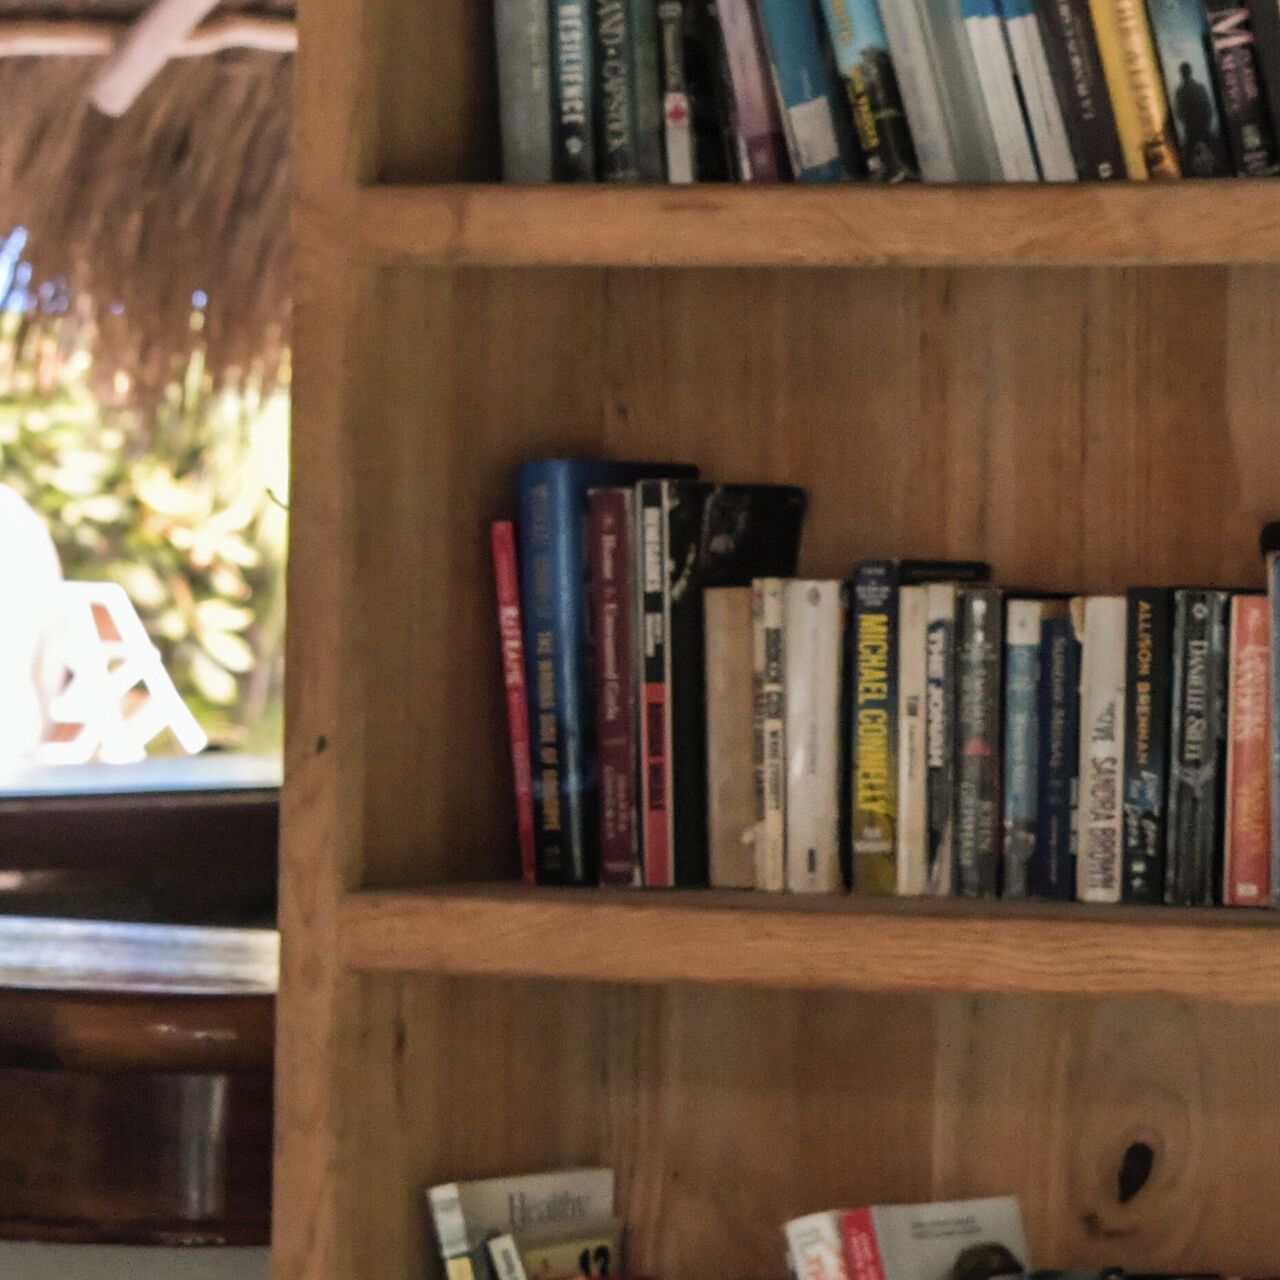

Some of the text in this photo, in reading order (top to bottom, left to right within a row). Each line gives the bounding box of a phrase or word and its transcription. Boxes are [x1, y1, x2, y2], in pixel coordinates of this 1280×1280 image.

[558, 2, 588, 125] RESILIENCE
[1205, 2, 1256, 51] M
[1137, 600, 1152, 675] ALLISON
[856, 612, 895, 815] MICHAEL CONNELLY
[1136, 681, 1151, 764] BRENNAN
[1183, 639, 1208, 762] DANIELLE STEEL
[1090, 756, 1117, 821] SANDRA
[1089, 827, 1116, 890] BROWN
